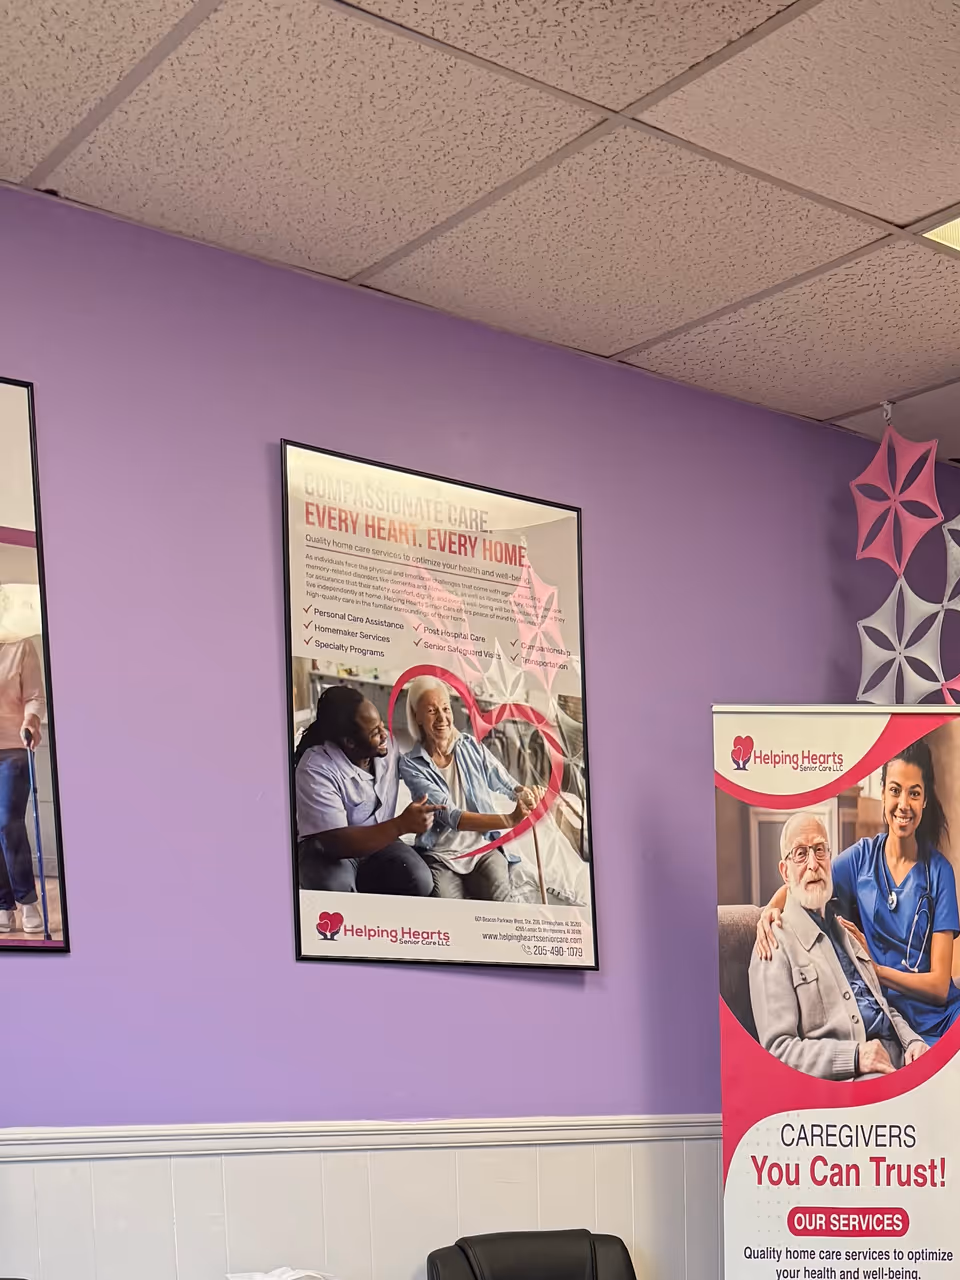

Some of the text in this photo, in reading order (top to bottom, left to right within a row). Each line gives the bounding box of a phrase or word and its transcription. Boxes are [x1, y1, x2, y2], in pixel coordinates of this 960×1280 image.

[304, 472, 493, 534] COMPASSIONATE CARE.
[304, 501, 531, 568] EVERY HEART. EVERY HOME.
[305, 534, 531, 585] Quality home care services to optimize your health and well-beg.
[314, 608, 404, 630] Personal Care Assistance
[314, 624, 390, 643] Homemaker Services
[423, 626, 486, 642] Post Hospital Care
[314, 640, 385, 657] Specialty Programs
[424, 642, 502, 660] Senior Safeguard Vists
[754, 750, 844, 770] Helping Hearts
[800, 764, 844, 772] Senior Care LLC
[344, 924, 450, 943] Helping Hearts
[482, 932, 582, 944] www.helpingheartsseniorcare.com
[534, 946, 582, 957] 205-490-1079
[780, 1123, 916, 1148] CAREGIVERS
[750, 1155, 946, 1188] You Can Trust!
[794, 1214, 902, 1232] OUR SERVICES
[744, 1246, 954, 1264] Quality home care services to optimize
[804, 1266, 836, 1280] health
[840, 1268, 860, 1280] and
